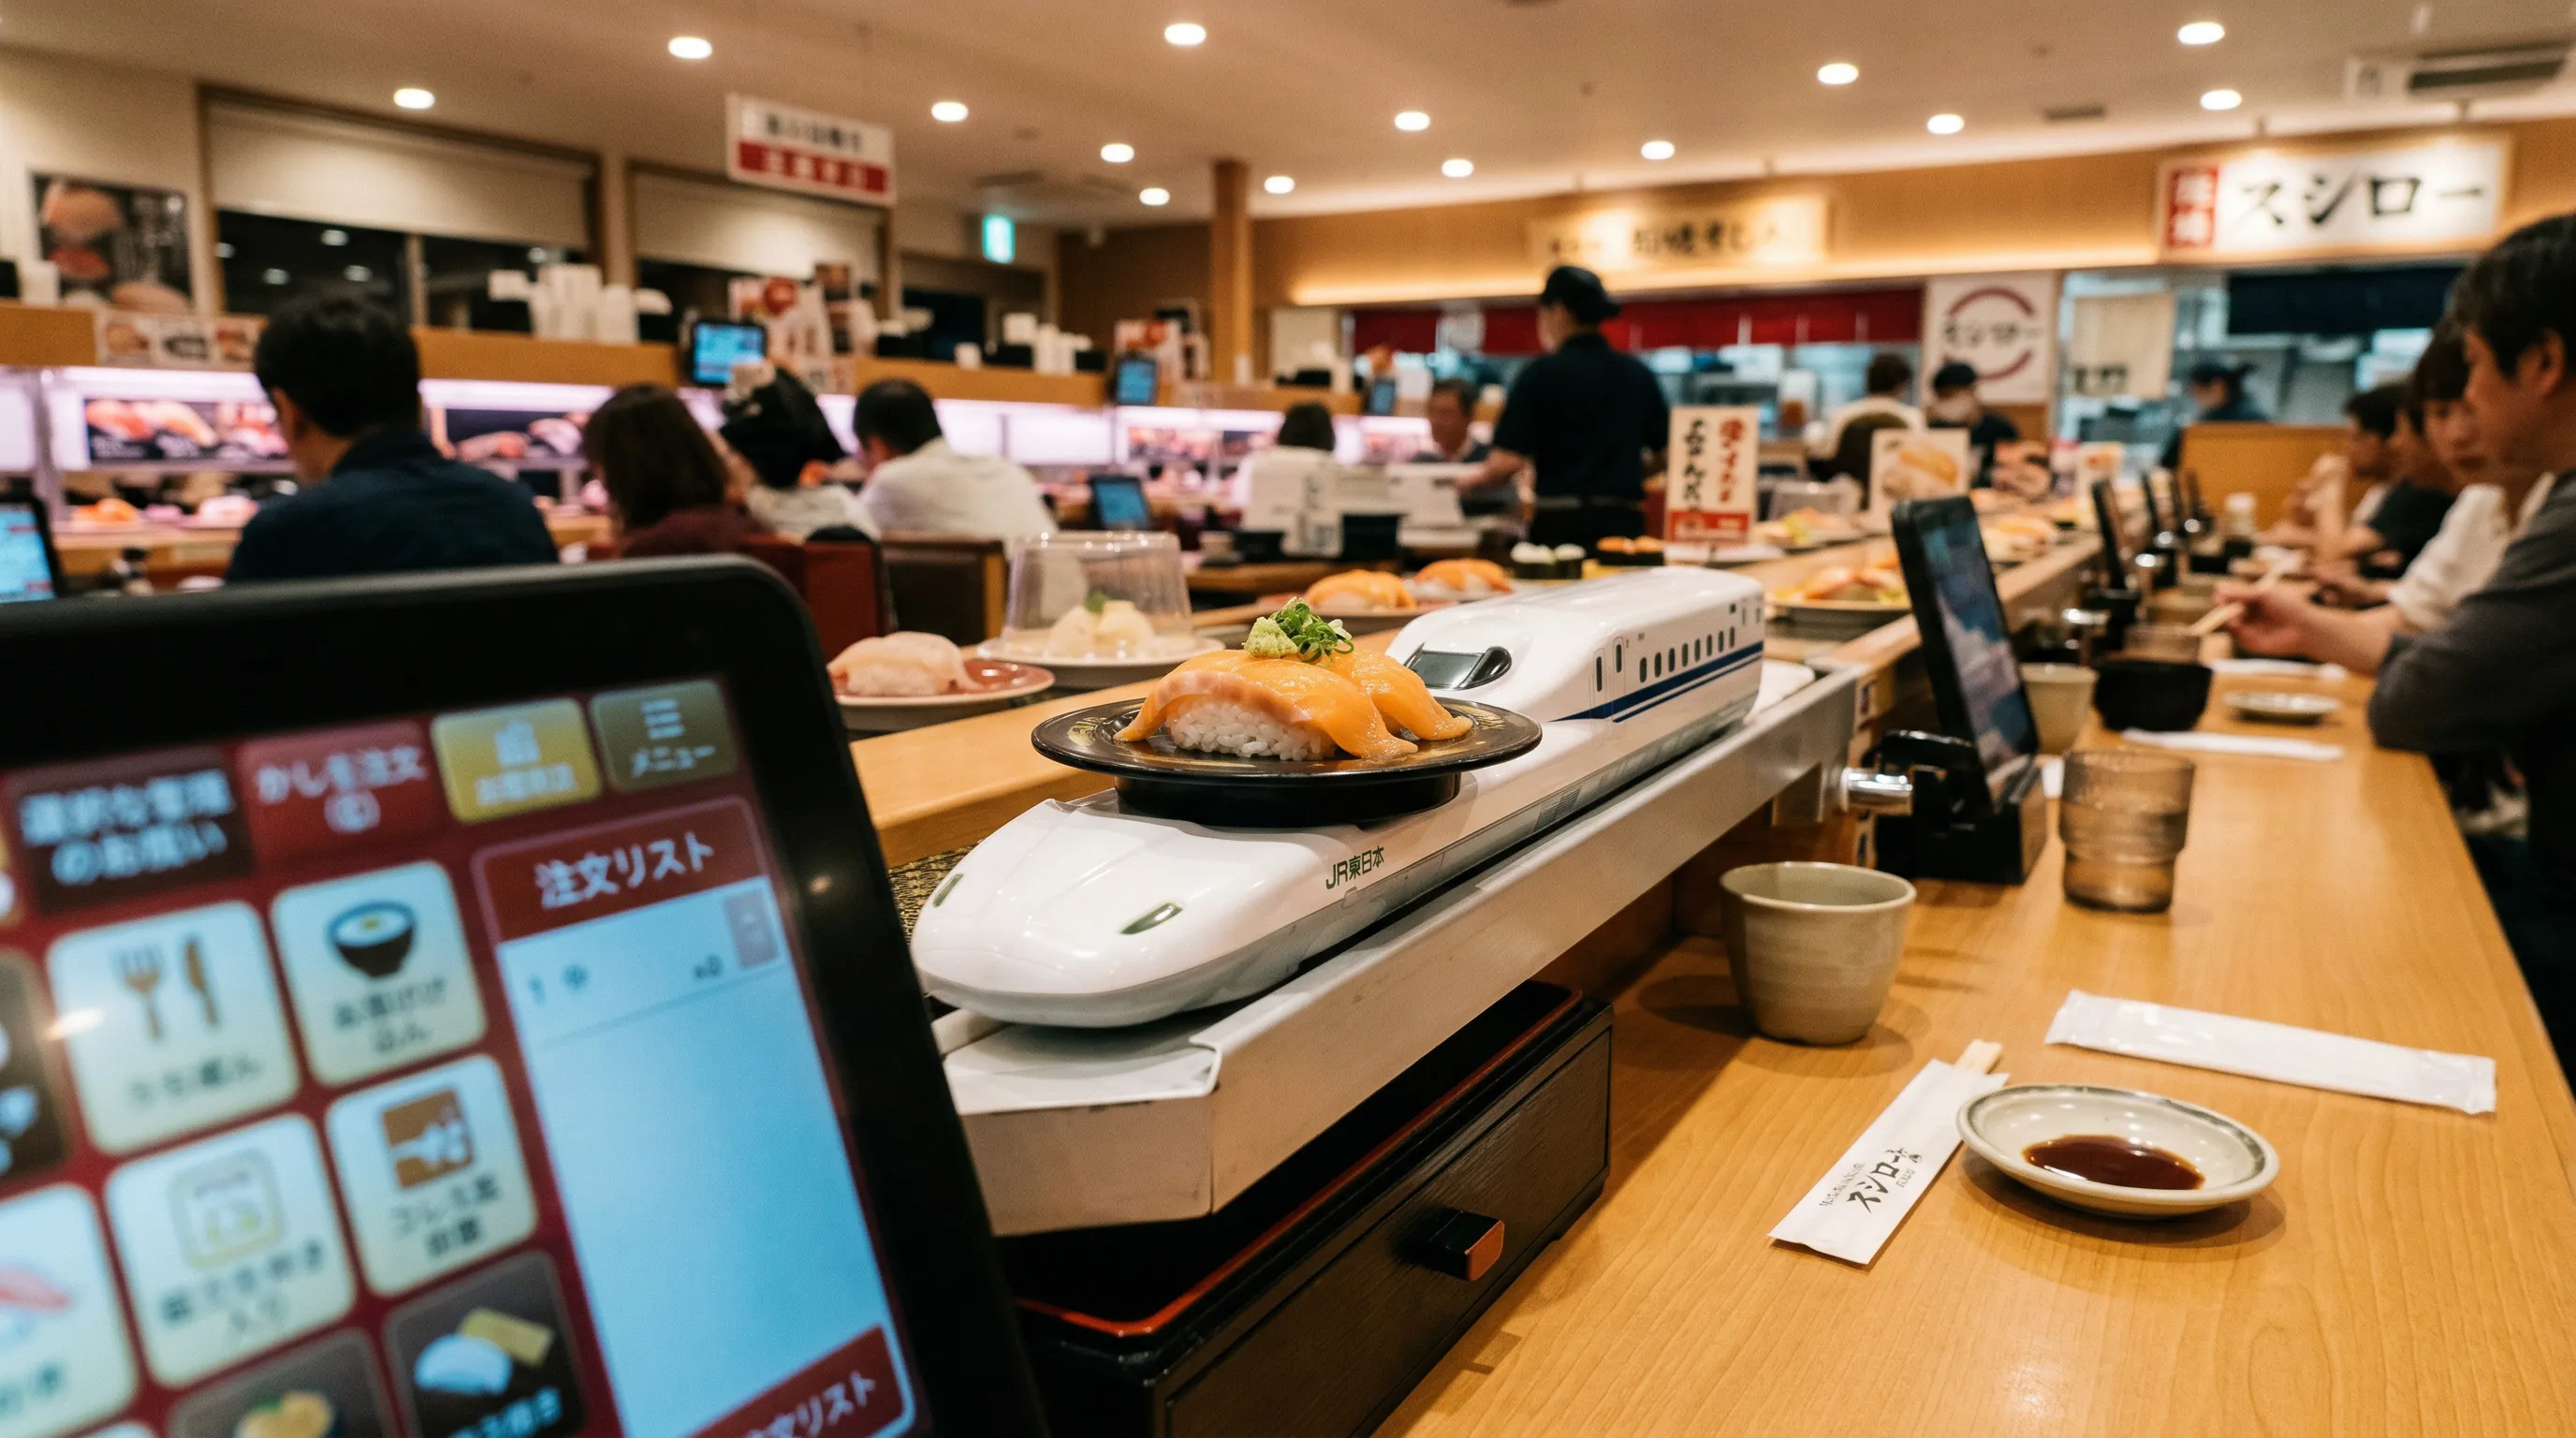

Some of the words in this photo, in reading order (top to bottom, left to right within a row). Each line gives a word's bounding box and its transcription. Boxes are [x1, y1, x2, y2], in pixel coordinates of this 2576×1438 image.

[2240, 169, 2485, 227] スシロー
[630, 743, 717, 779] メニュー
[534, 830, 715, 910] 注文リスト
[1325, 845, 1385, 889] JR東日本
[1846, 1154, 1900, 1214] スシロー
[744, 1370, 876, 1438] 文リスト
